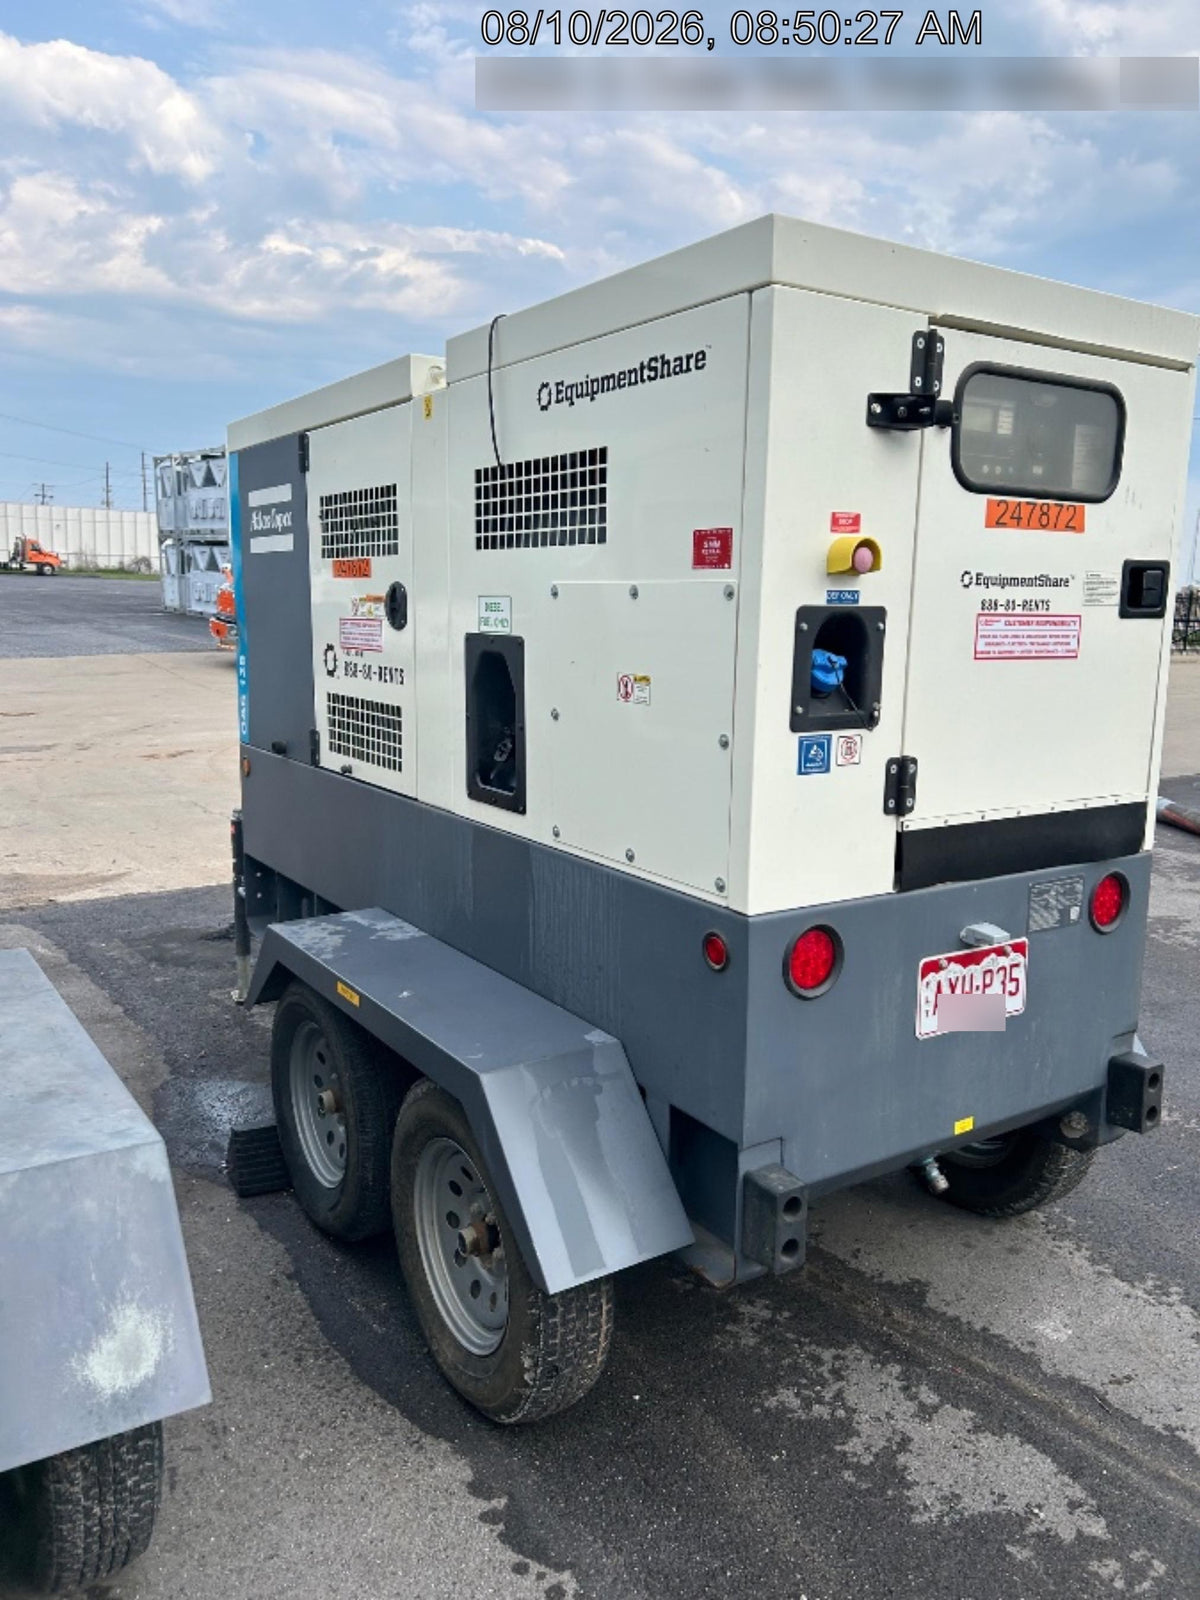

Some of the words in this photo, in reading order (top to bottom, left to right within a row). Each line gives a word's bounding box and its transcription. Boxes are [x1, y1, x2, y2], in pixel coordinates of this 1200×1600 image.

[554, 348, 707, 407] EquipmentShare
[994, 499, 1077, 530] 247872
[974, 571, 1070, 590] EquipmentShare
